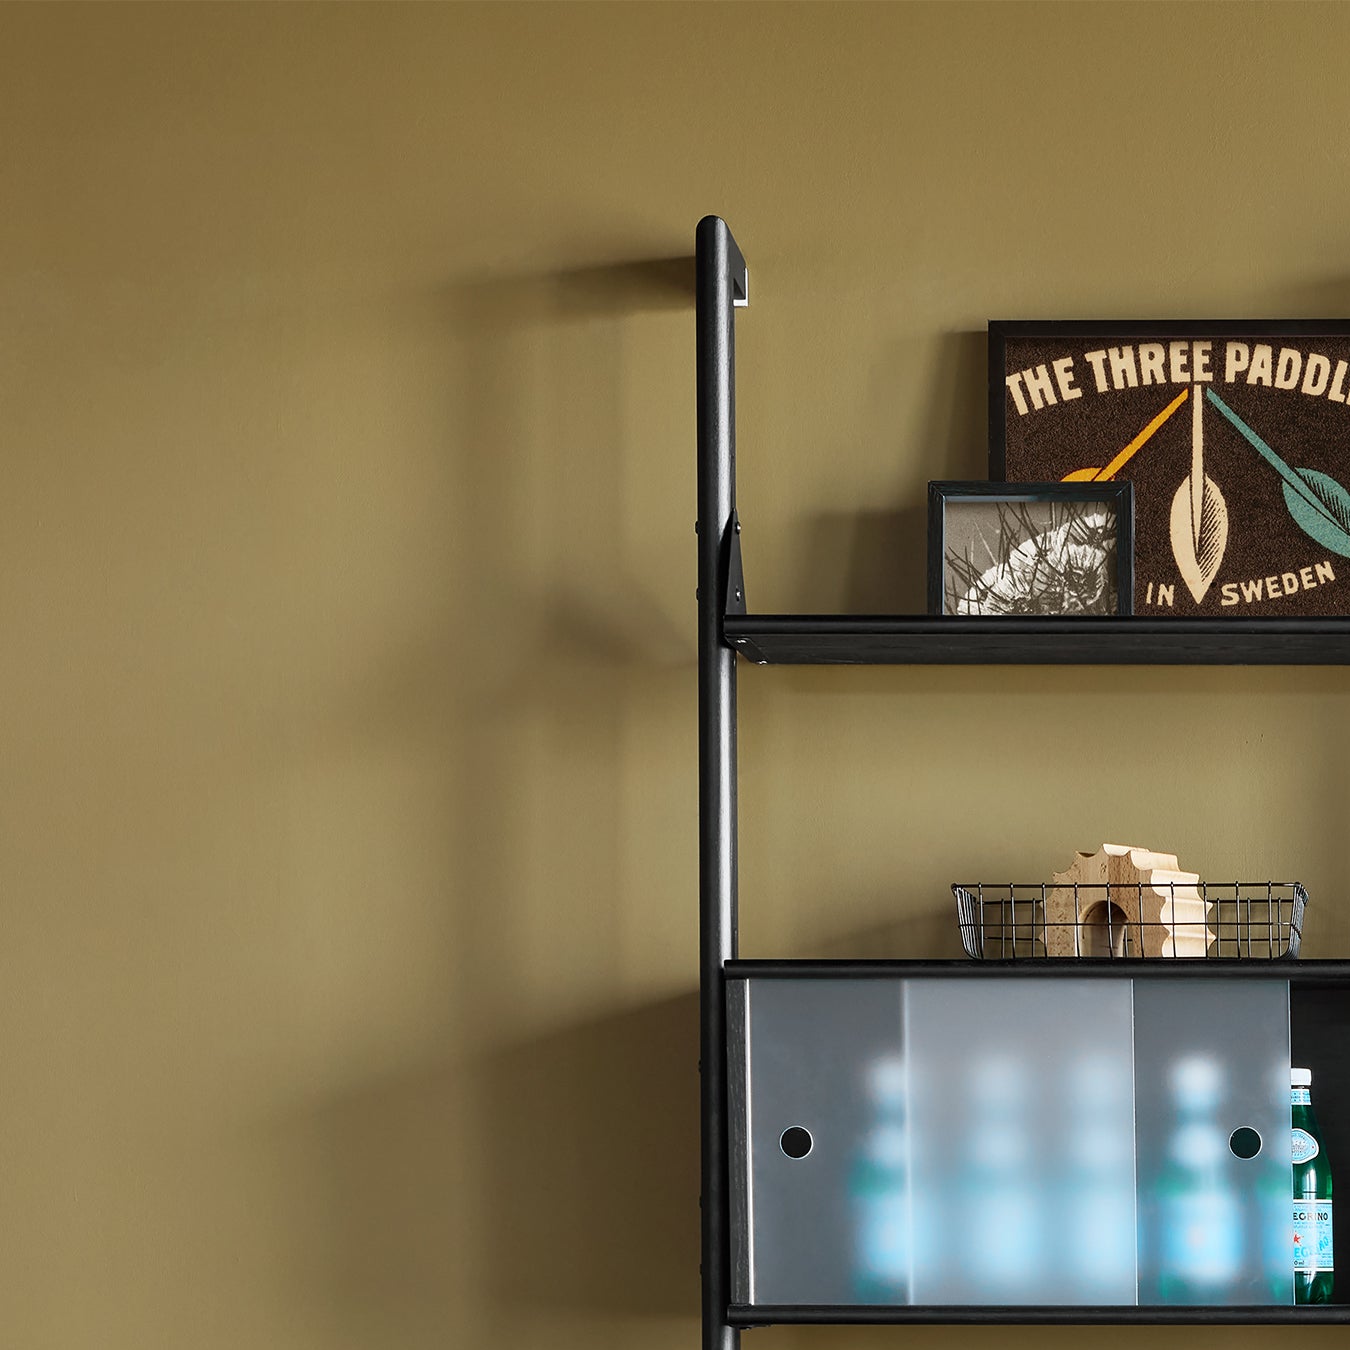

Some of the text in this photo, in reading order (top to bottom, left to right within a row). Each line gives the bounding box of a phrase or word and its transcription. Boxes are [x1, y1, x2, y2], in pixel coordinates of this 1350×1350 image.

[1005, 357, 1083, 416] THE
[1085, 341, 1214, 393] THREE
[1145, 561, 1337, 607] IN SWEDEN
